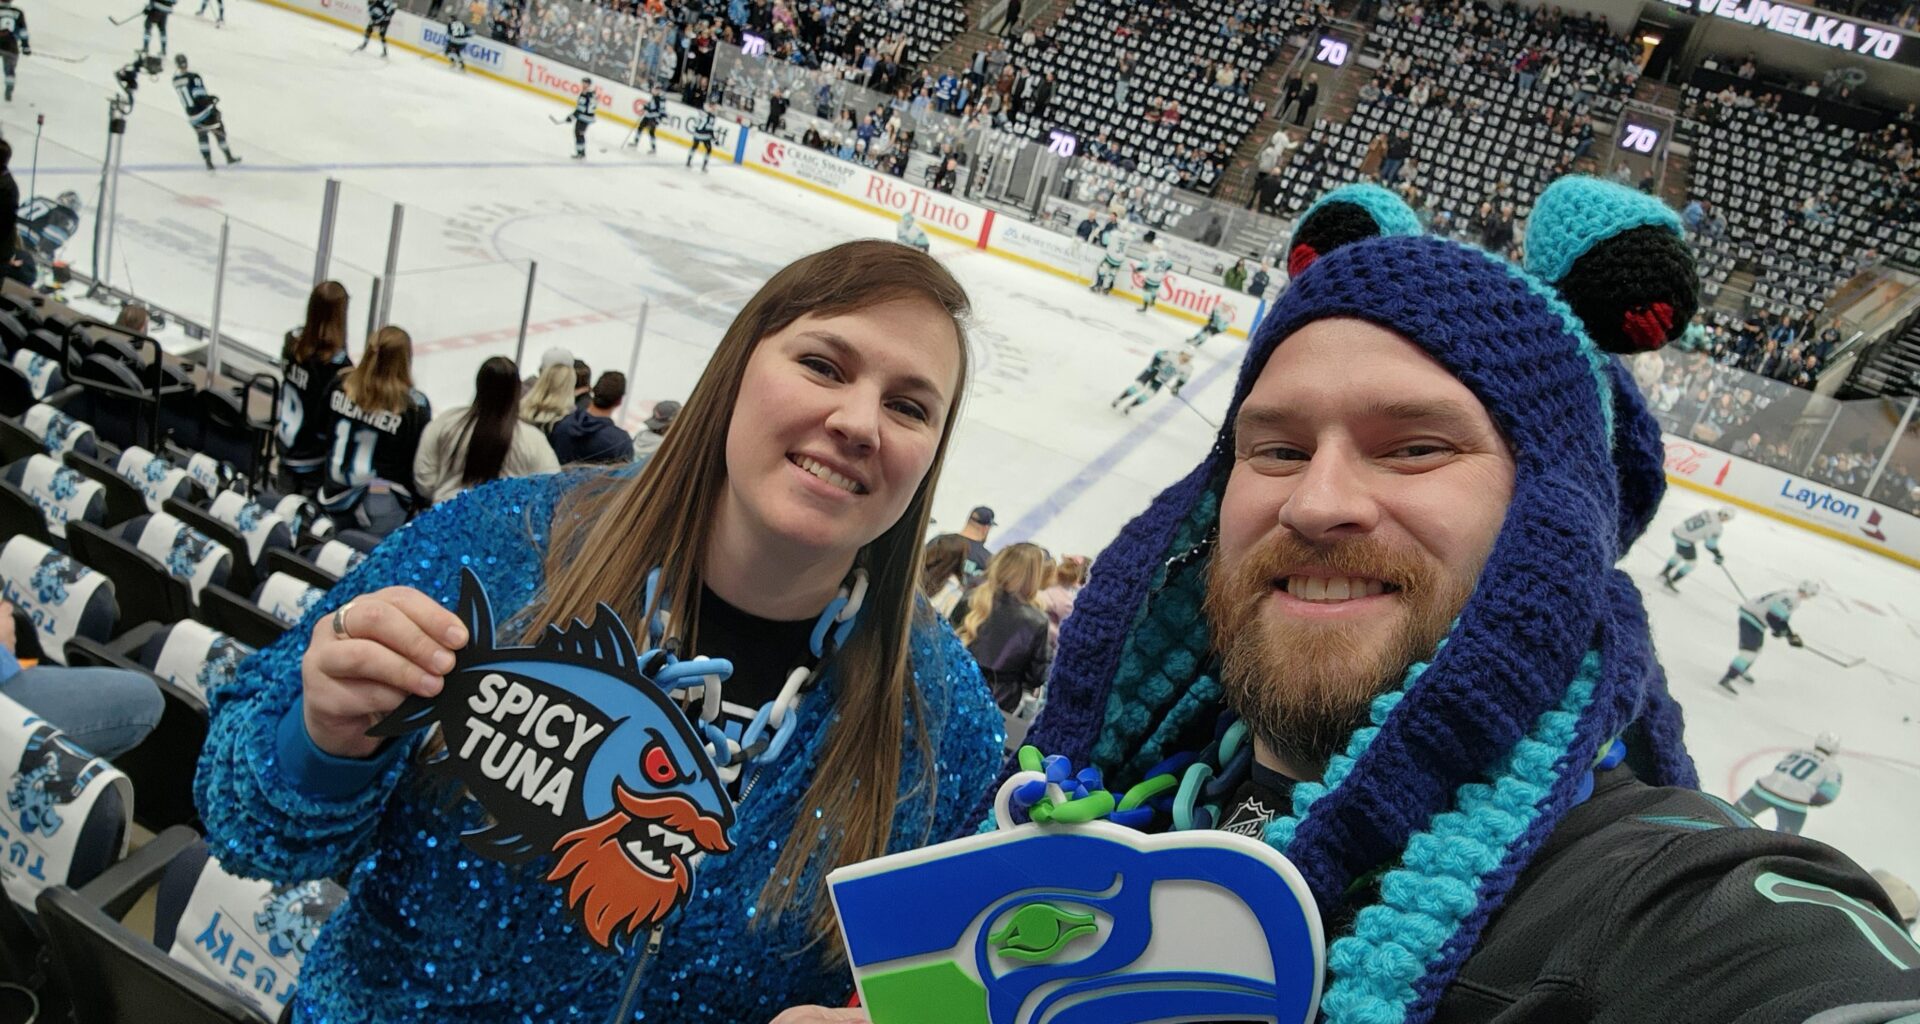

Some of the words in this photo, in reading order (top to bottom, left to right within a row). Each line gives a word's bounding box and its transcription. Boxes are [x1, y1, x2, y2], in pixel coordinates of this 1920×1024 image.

[741, 33, 765, 56] 70
[1317, 38, 1348, 66] 70
[1698, 0, 1856, 51] VEJMELKA
[1857, 27, 1900, 60] 70
[1048, 131, 1076, 158] 70
[1622, 124, 1657, 153] 70
[865, 174, 907, 210] Rio
[909, 188, 969, 231] Tinto
[330, 418, 379, 487] 11
[1780, 479, 1860, 519] Layton
[467, 673, 605, 761] SPICY
[459, 716, 574, 817] TUNA
[1775, 754, 1818, 780] 20
[195, 911, 297, 1009] TUSKY
